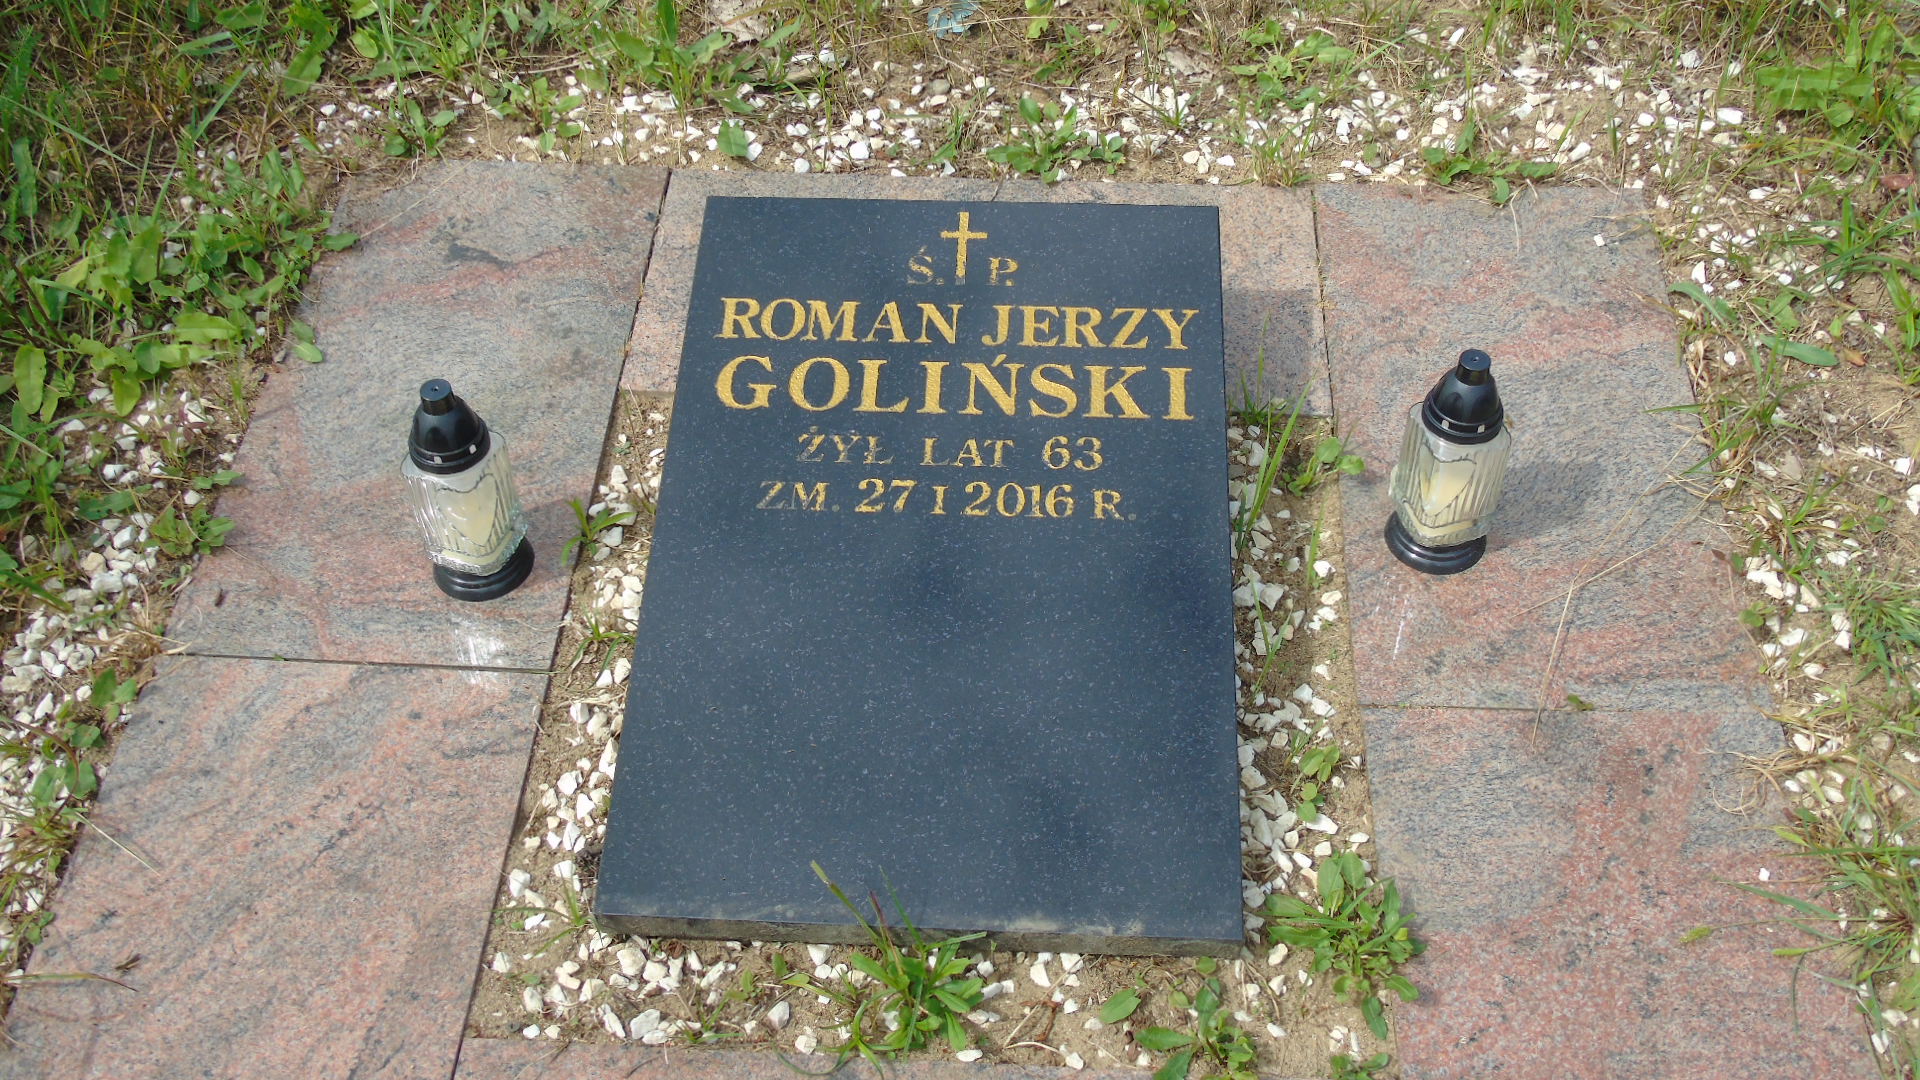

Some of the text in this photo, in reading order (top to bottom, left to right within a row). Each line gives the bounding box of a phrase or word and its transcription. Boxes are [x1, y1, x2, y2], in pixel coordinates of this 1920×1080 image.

[905, 245, 1019, 287] Ś. P.
[713, 297, 1200, 351] ROMAN JERZY
[714, 353, 1196, 421] GOLIŃSKI
[796, 425, 1104, 471] ŻYŁ LAT 63
[755, 479, 840, 513] ZM.
[854, 478, 918, 514] 27
[962, 480, 1077, 519] 2016
[1091, 488, 1138, 521] R.
